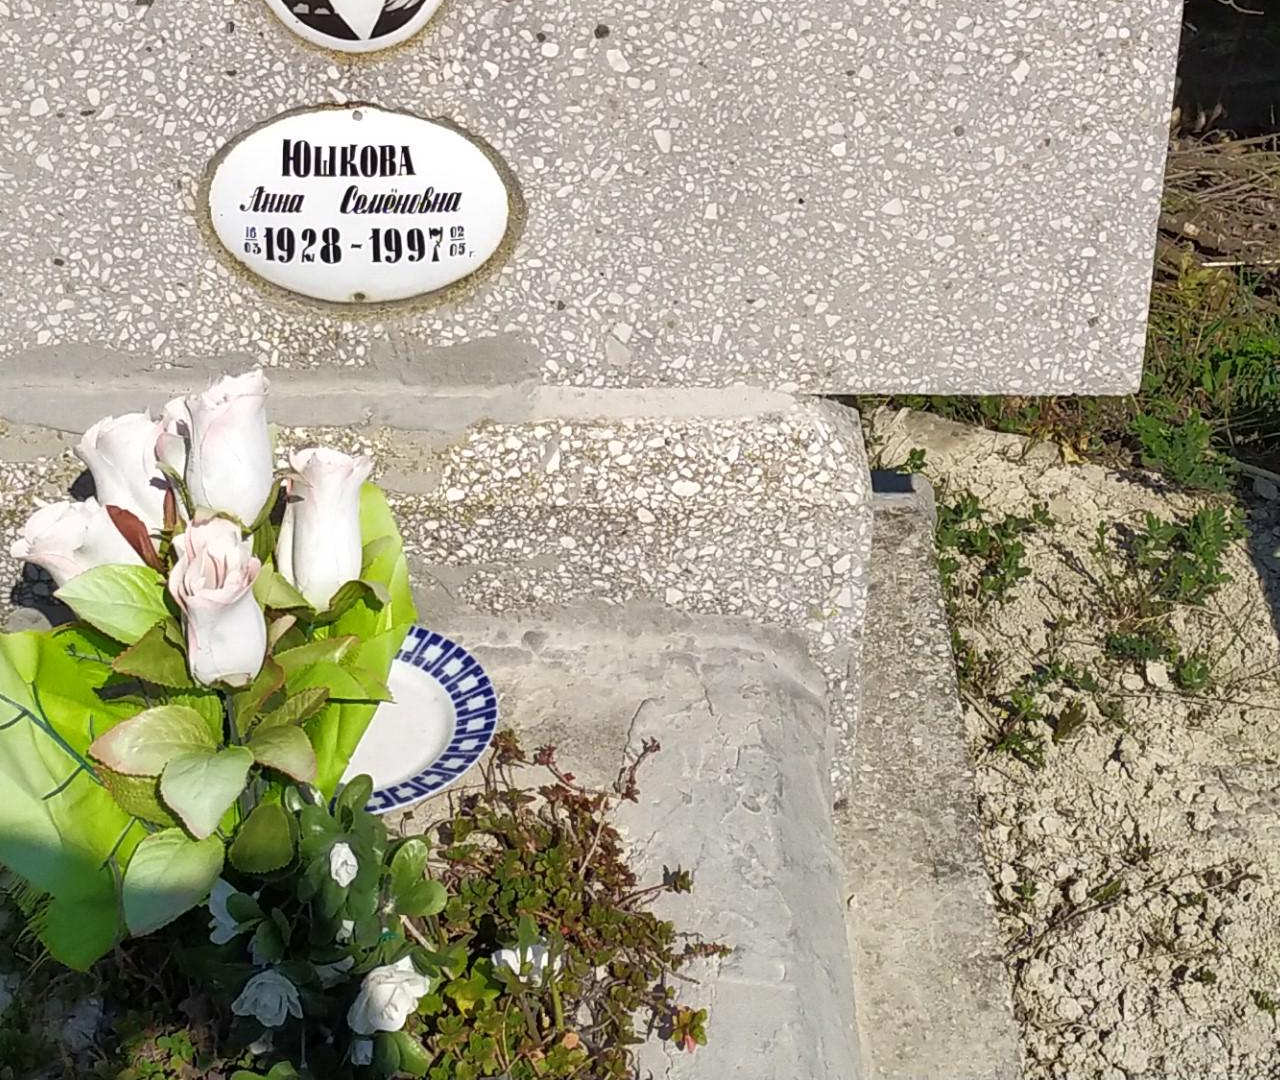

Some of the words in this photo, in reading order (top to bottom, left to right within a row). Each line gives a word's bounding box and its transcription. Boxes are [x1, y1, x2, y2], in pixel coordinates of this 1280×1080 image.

[281, 138, 417, 178] ЮШКОВА
[239, 185, 306, 213] Анна
[339, 184, 463, 215] Семёновна
